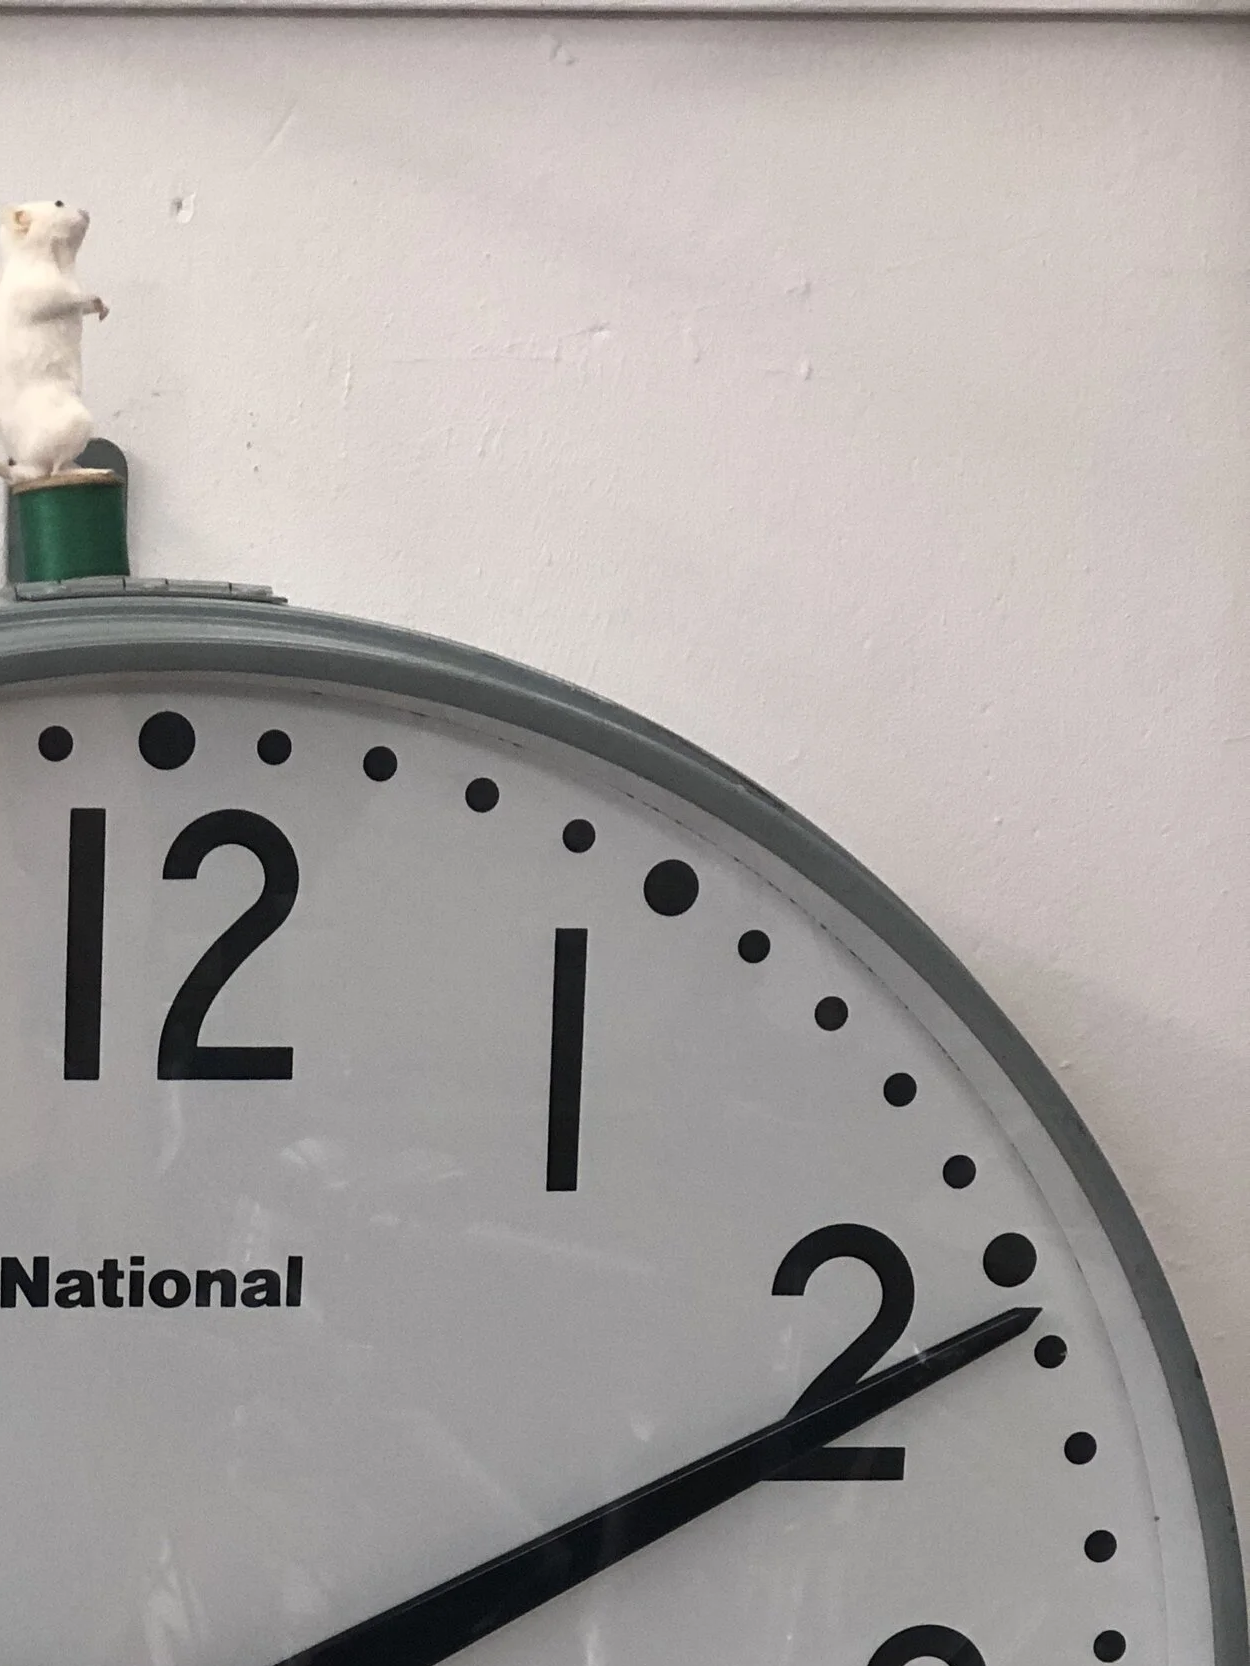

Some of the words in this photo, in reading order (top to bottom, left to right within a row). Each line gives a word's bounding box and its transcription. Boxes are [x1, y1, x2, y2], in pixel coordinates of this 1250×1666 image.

[62, 806, 301, 1082] 12
[544, 926, 590, 1194] 1
[0, 1255, 305, 1310] National
[760, 1223, 916, 1482] 2
